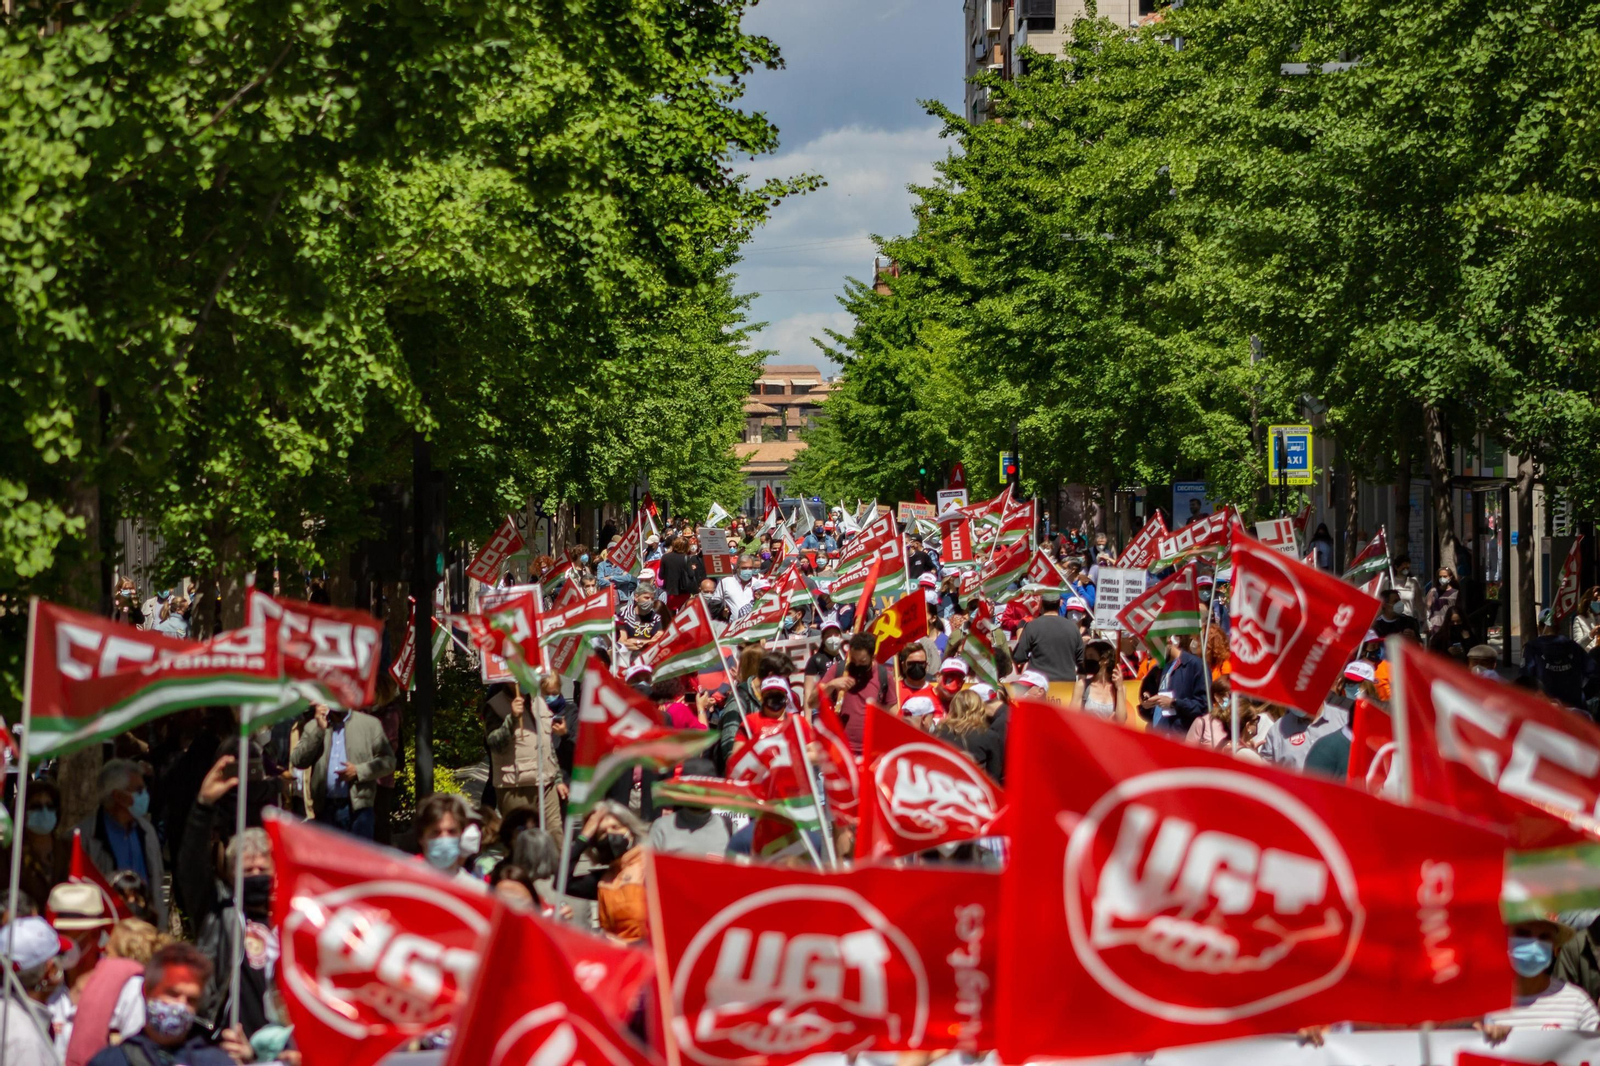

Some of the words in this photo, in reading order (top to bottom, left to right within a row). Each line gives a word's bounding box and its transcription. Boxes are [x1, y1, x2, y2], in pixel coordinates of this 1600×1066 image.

[949, 521, 962, 560] CCOO
[1095, 804, 1328, 917] UGT
[706, 928, 891, 1018] UGT
